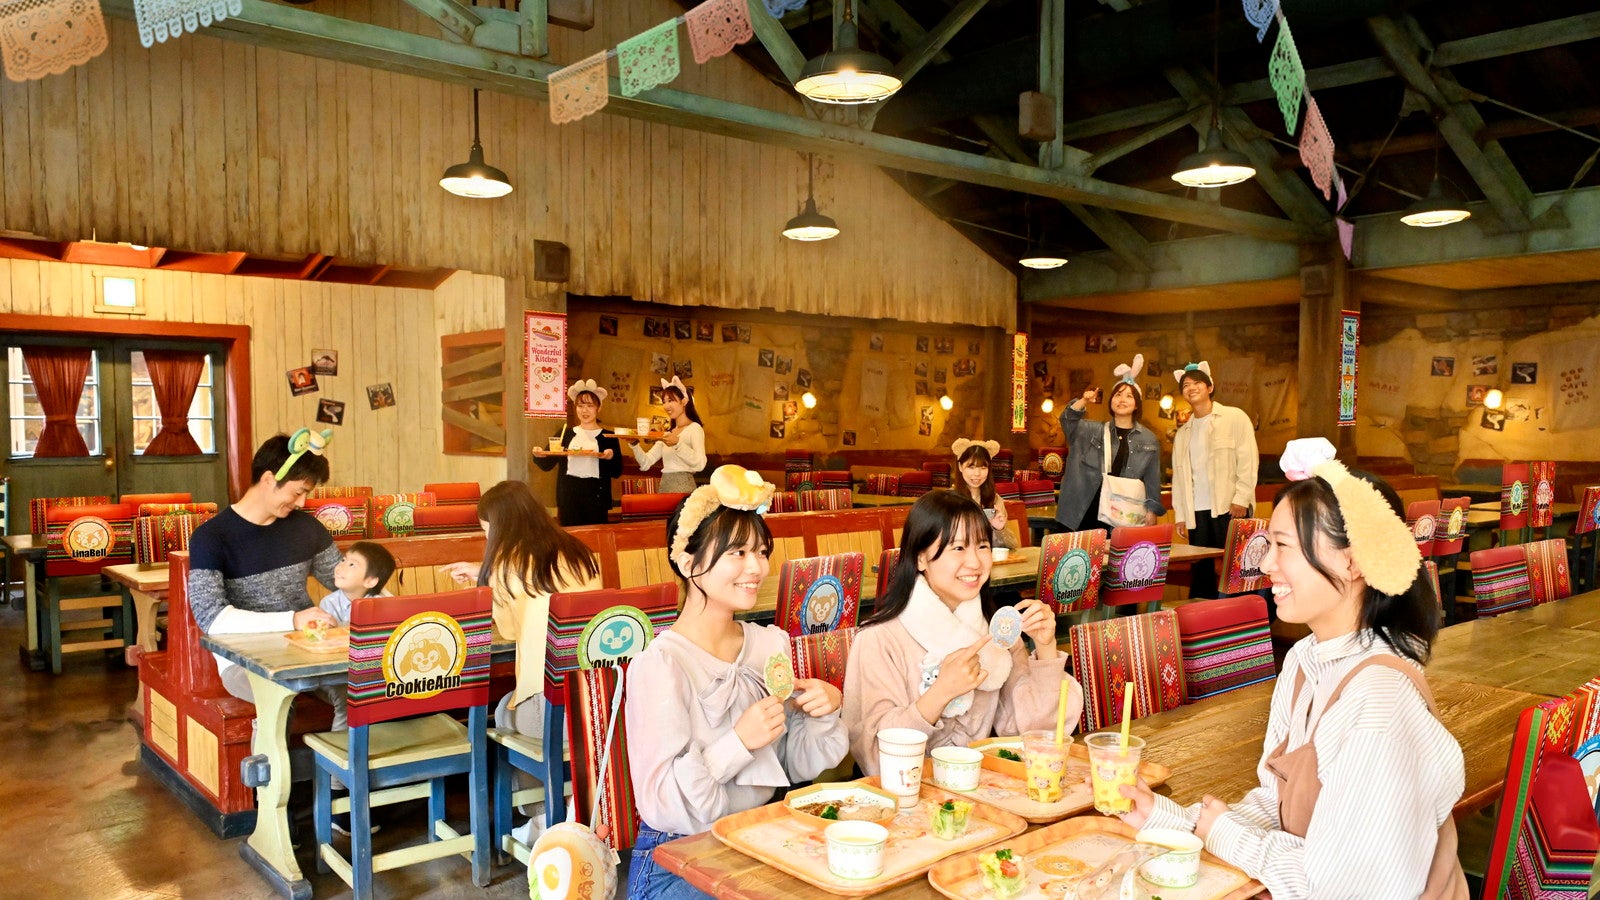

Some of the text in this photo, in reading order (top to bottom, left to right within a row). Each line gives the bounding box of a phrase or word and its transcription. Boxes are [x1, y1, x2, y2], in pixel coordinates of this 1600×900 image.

[531, 347, 562, 356] Wonderful
[535, 354, 559, 363] Kitchen
[72, 549, 107, 558] LinaBell
[1122, 578, 1154, 589] StellaLou
[810, 623, 830, 634] Duffy
[386, 675, 461, 698] CookieAnn
